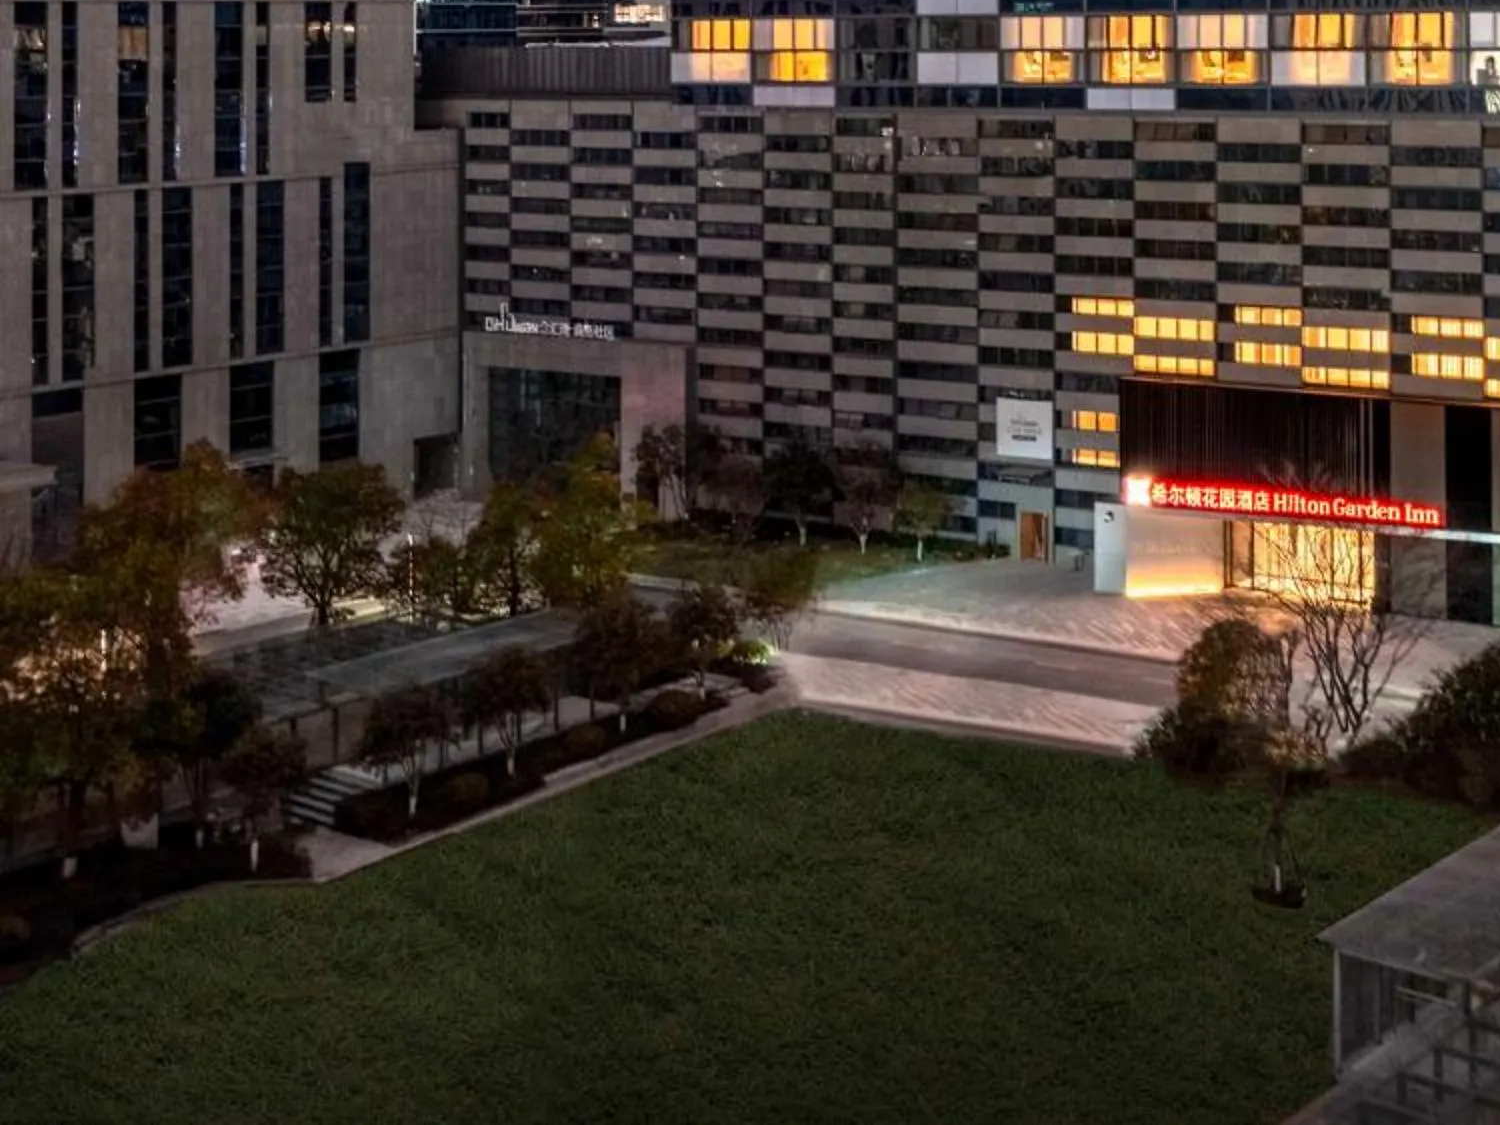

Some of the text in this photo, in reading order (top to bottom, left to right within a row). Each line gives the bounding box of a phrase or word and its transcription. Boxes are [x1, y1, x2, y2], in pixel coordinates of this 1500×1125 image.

[1151, 481, 1270, 513] 希尔顿花园酒店
[1273, 492, 1440, 526] Hilton Garden Inn
